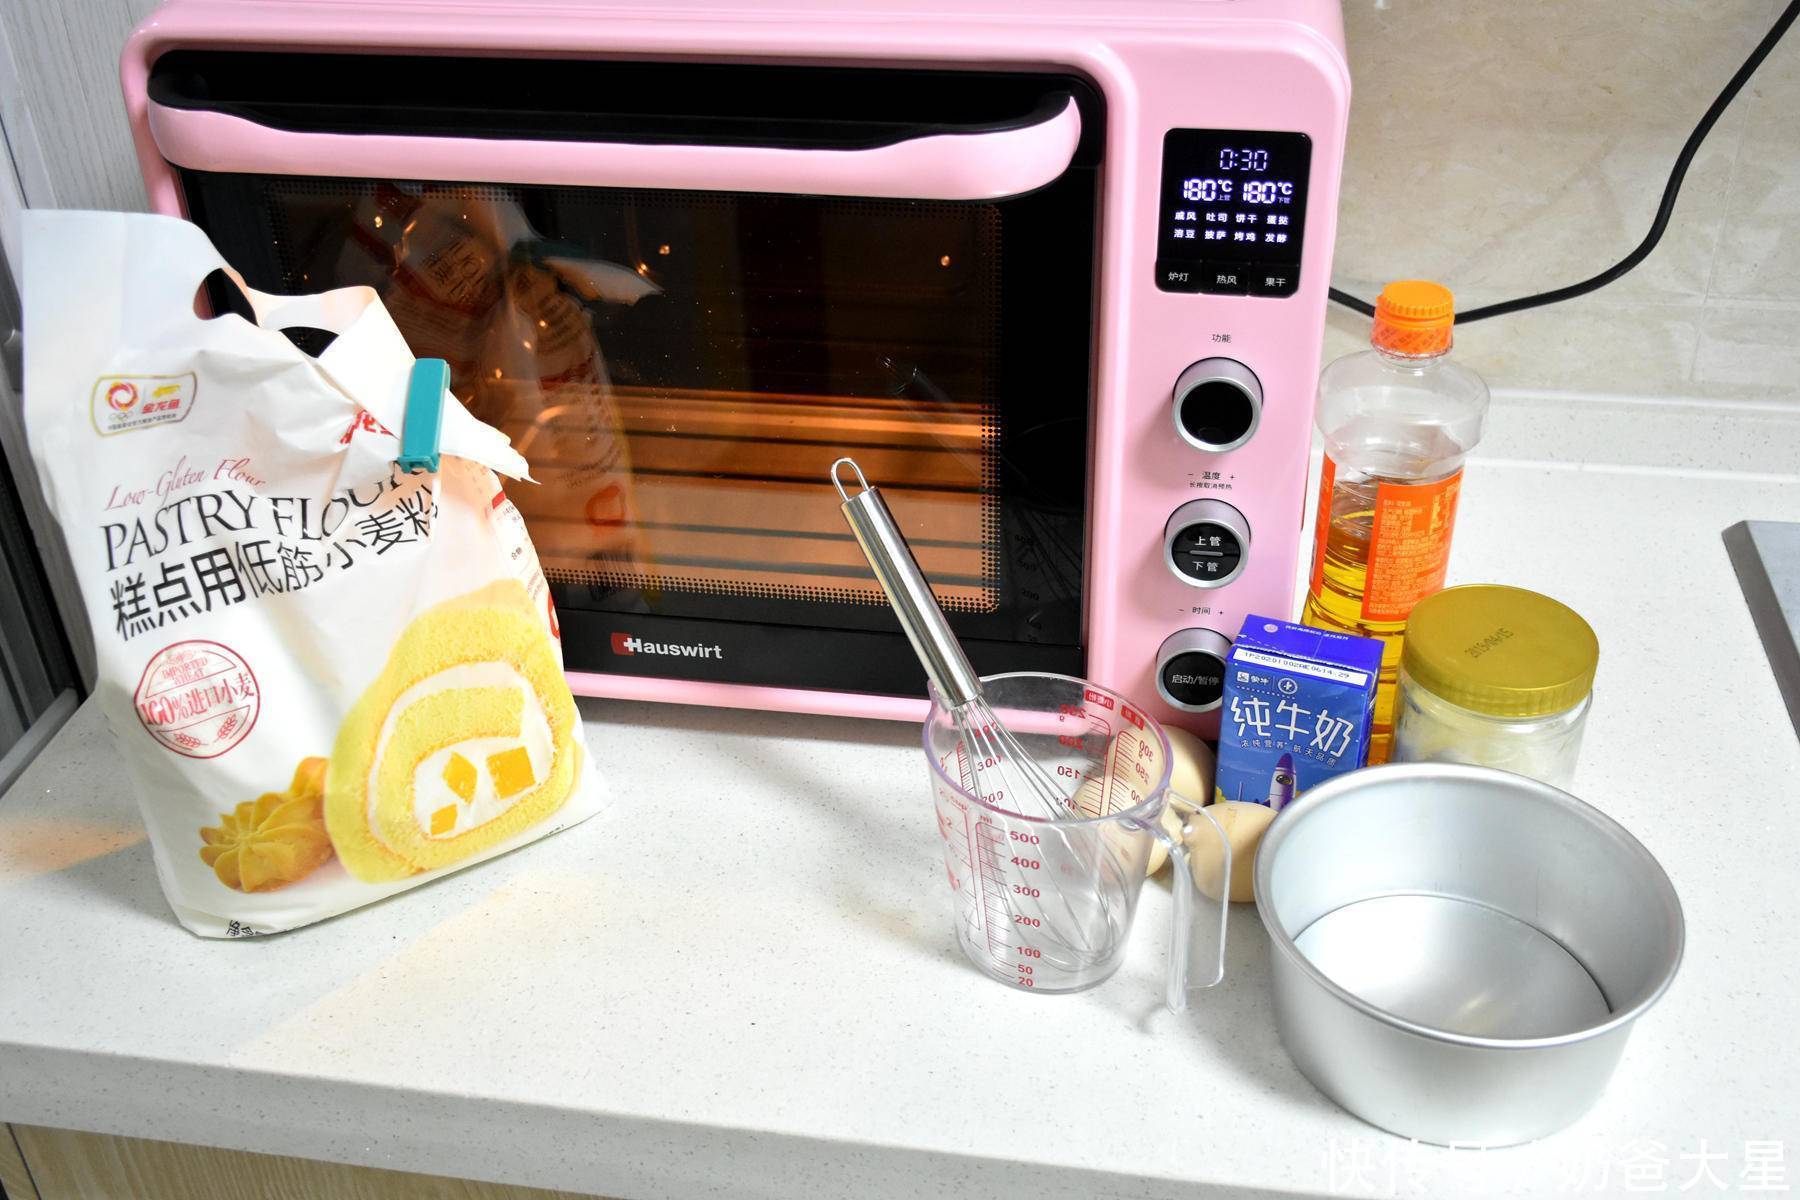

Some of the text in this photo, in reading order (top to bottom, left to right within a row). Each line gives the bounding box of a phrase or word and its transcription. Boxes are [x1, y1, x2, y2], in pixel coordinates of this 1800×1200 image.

[1220, 149, 1268, 171] 0:30
[1206, 212, 1228, 223] 吐司
[1236, 214, 1257, 224] 饼干
[1267, 215, 1289, 225] 蛋挞
[1205, 231, 1227, 240] 披萨
[1234, 232, 1256, 242] 烤鸡
[1265, 233, 1287, 243] 发酵
[1168, 272, 1287, 287] 炉灯 热风 果干
[1212, 334, 1231, 343] 功能
[1202, 471, 1221, 480] 温度
[104, 455, 267, 511] Low-Gluten Flour
[100, 489, 259, 572] PASTRY
[1194, 536, 1222, 547] 上管
[111, 484, 438, 642] 糕点用低筋小麦粉
[1192, 561, 1219, 572] 下管
[1192, 607, 1210, 615] 时间
[623, 637, 723, 659] Hauswirt
[1171, 675, 1220, 686] 启动/暂停
[1231, 697, 1354, 757] 纯牛奶
[1293, 744, 1337, 767] 航天品质
[1010, 830, 1040, 845] 500
[1010, 856, 1040, 870] 400
[1013, 884, 1040, 898] 300
[1014, 914, 1041, 928] 200
[1016, 946, 1041, 959] 100
[1017, 963, 1033, 975] 50
[1017, 976, 1034, 988] 20
